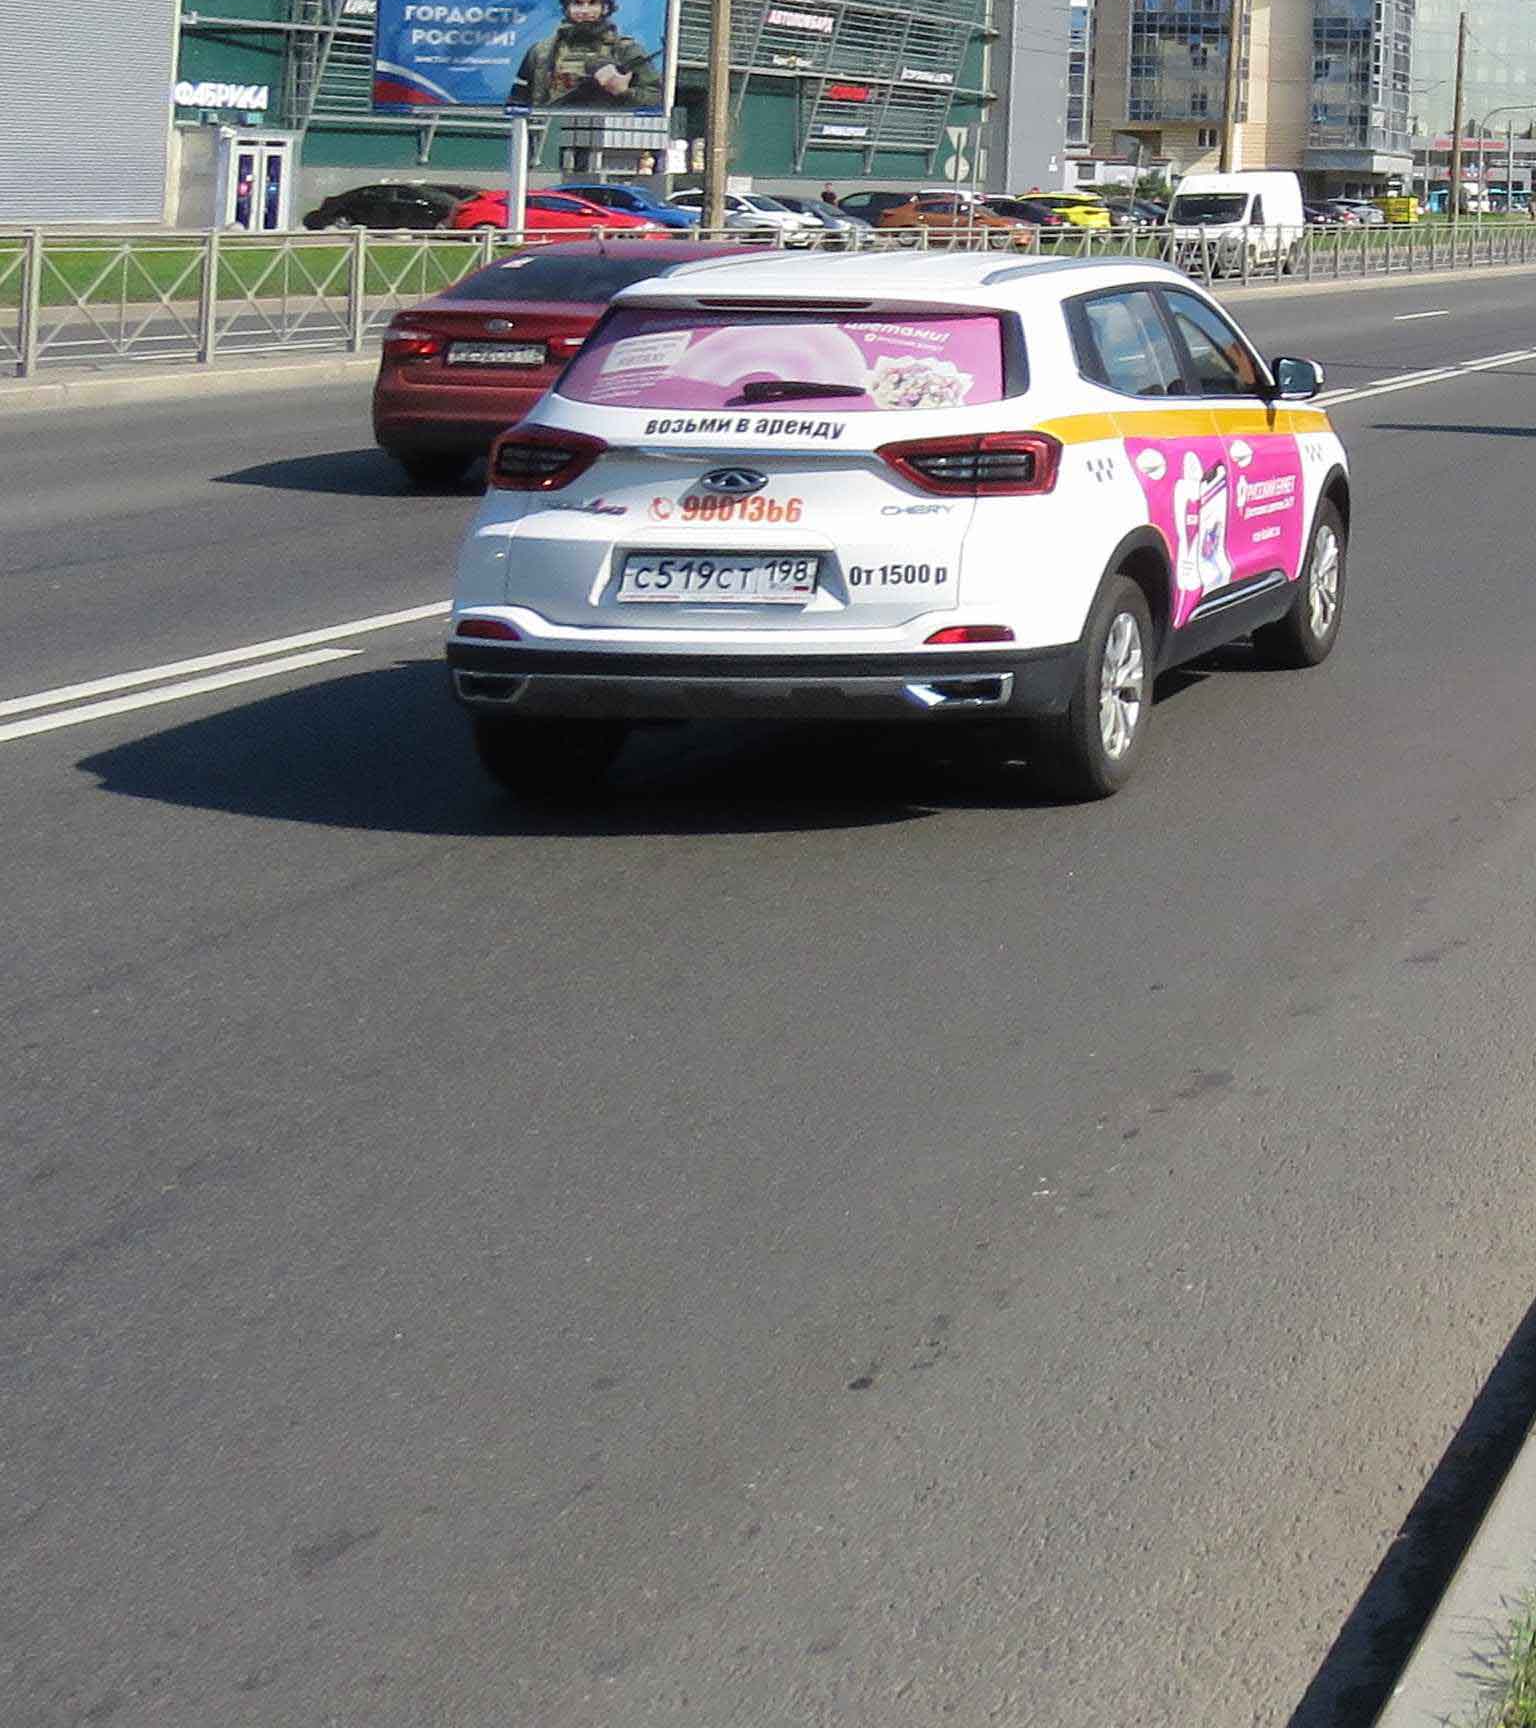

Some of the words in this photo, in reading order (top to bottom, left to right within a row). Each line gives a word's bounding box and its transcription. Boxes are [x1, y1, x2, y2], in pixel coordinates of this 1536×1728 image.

[403, 3, 529, 26] ГОРДОСТЬ
[411, 28, 516, 47] РОССИИ!
[174, 81, 269, 110] ФАБРИКА
[644, 416, 729, 437] возьми
[735, 418, 750, 434] в
[754, 418, 847, 441] аренду
[880, 504, 955, 517] CHERY
[633, 564, 751, 591] С519СТ
[763, 560, 810, 583] 198
[849, 565, 875, 586] От
[879, 563, 931, 585] 1500
[935, 565, 948, 585] р
